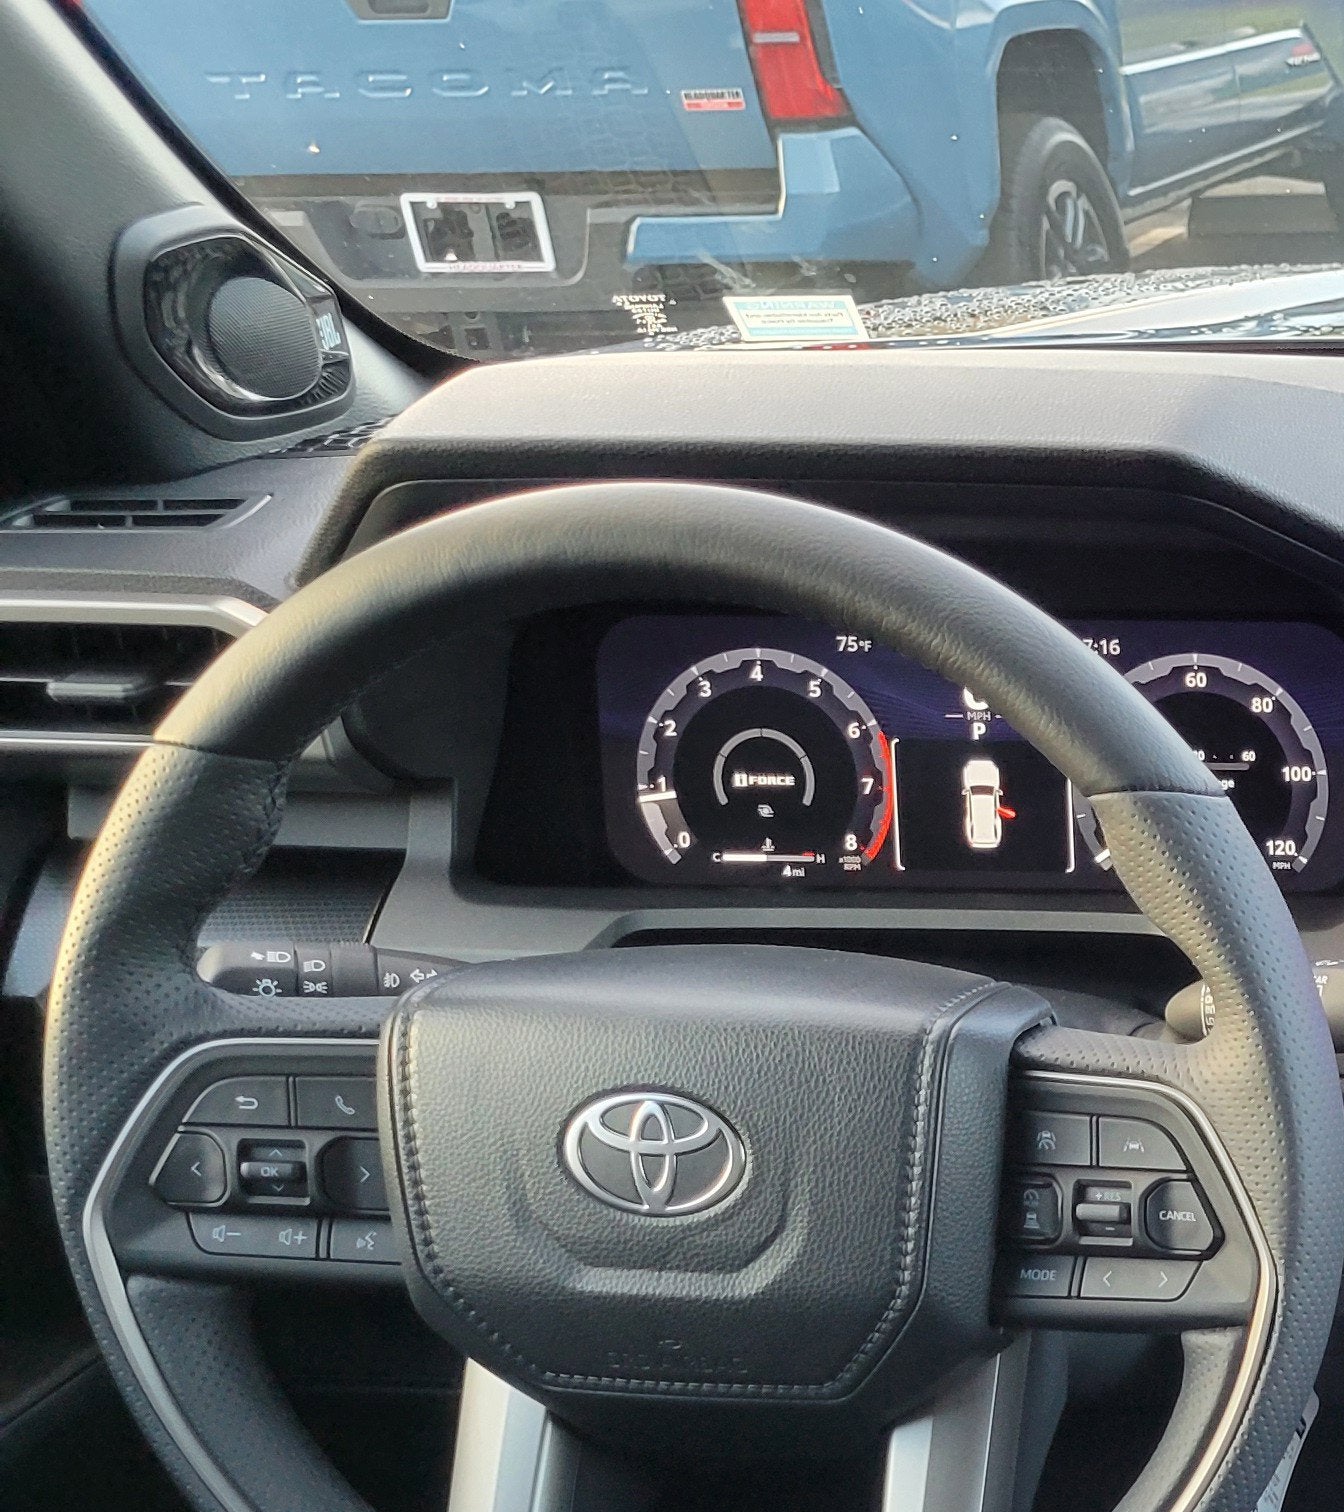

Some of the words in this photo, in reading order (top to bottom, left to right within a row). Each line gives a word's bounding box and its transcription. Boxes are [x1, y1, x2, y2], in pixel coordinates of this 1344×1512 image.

[749, 665, 763, 681] 4
[1185, 672, 1207, 688] 60
[698, 681, 712, 698] 3
[808, 681, 822, 698] 5
[1251, 698, 1274, 713] 80
[967, 711, 991, 721] MPH
[664, 720, 678, 737] 2
[848, 722, 861, 738] 6
[973, 722, 987, 740] P
[1281, 767, 1313, 783] 100
[656, 776, 667, 792] 1
[861, 777, 875, 795] 7
[678, 832, 691, 849] 0
[844, 833, 858, 851] 8
[1266, 840, 1296, 857] 120
[1272, 861, 1291, 871] MPH
[261, 1166, 279, 1178] OK
[1159, 1210, 1196, 1222] CANCEL
[1020, 1269, 1057, 1281] MODE
